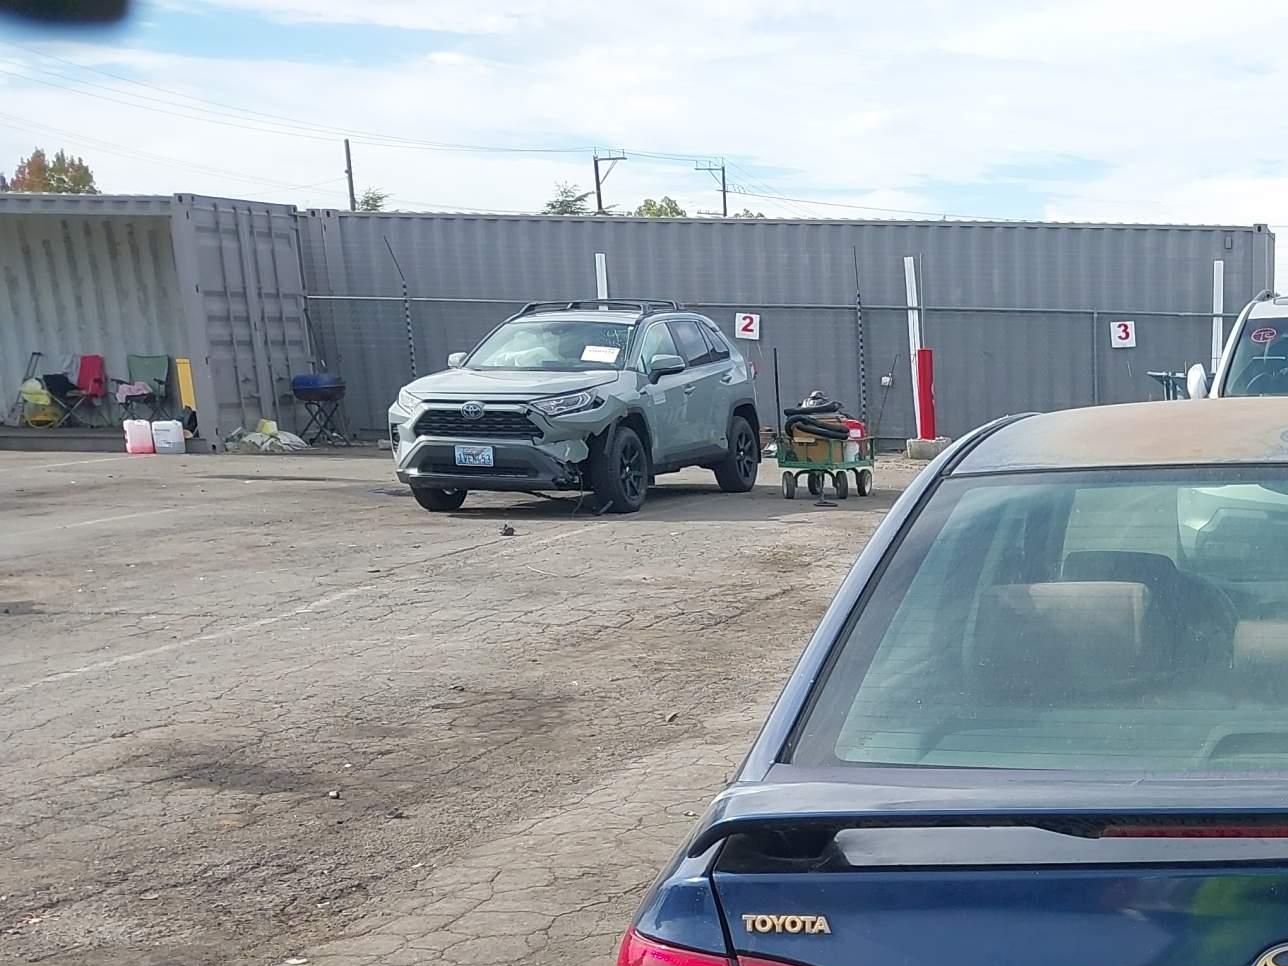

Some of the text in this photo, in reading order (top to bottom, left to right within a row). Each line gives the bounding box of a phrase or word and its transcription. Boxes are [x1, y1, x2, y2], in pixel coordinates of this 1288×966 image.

[741, 315, 754, 332] 2
[1117, 323, 1130, 341] 3
[741, 914, 832, 934] TOYOTA
